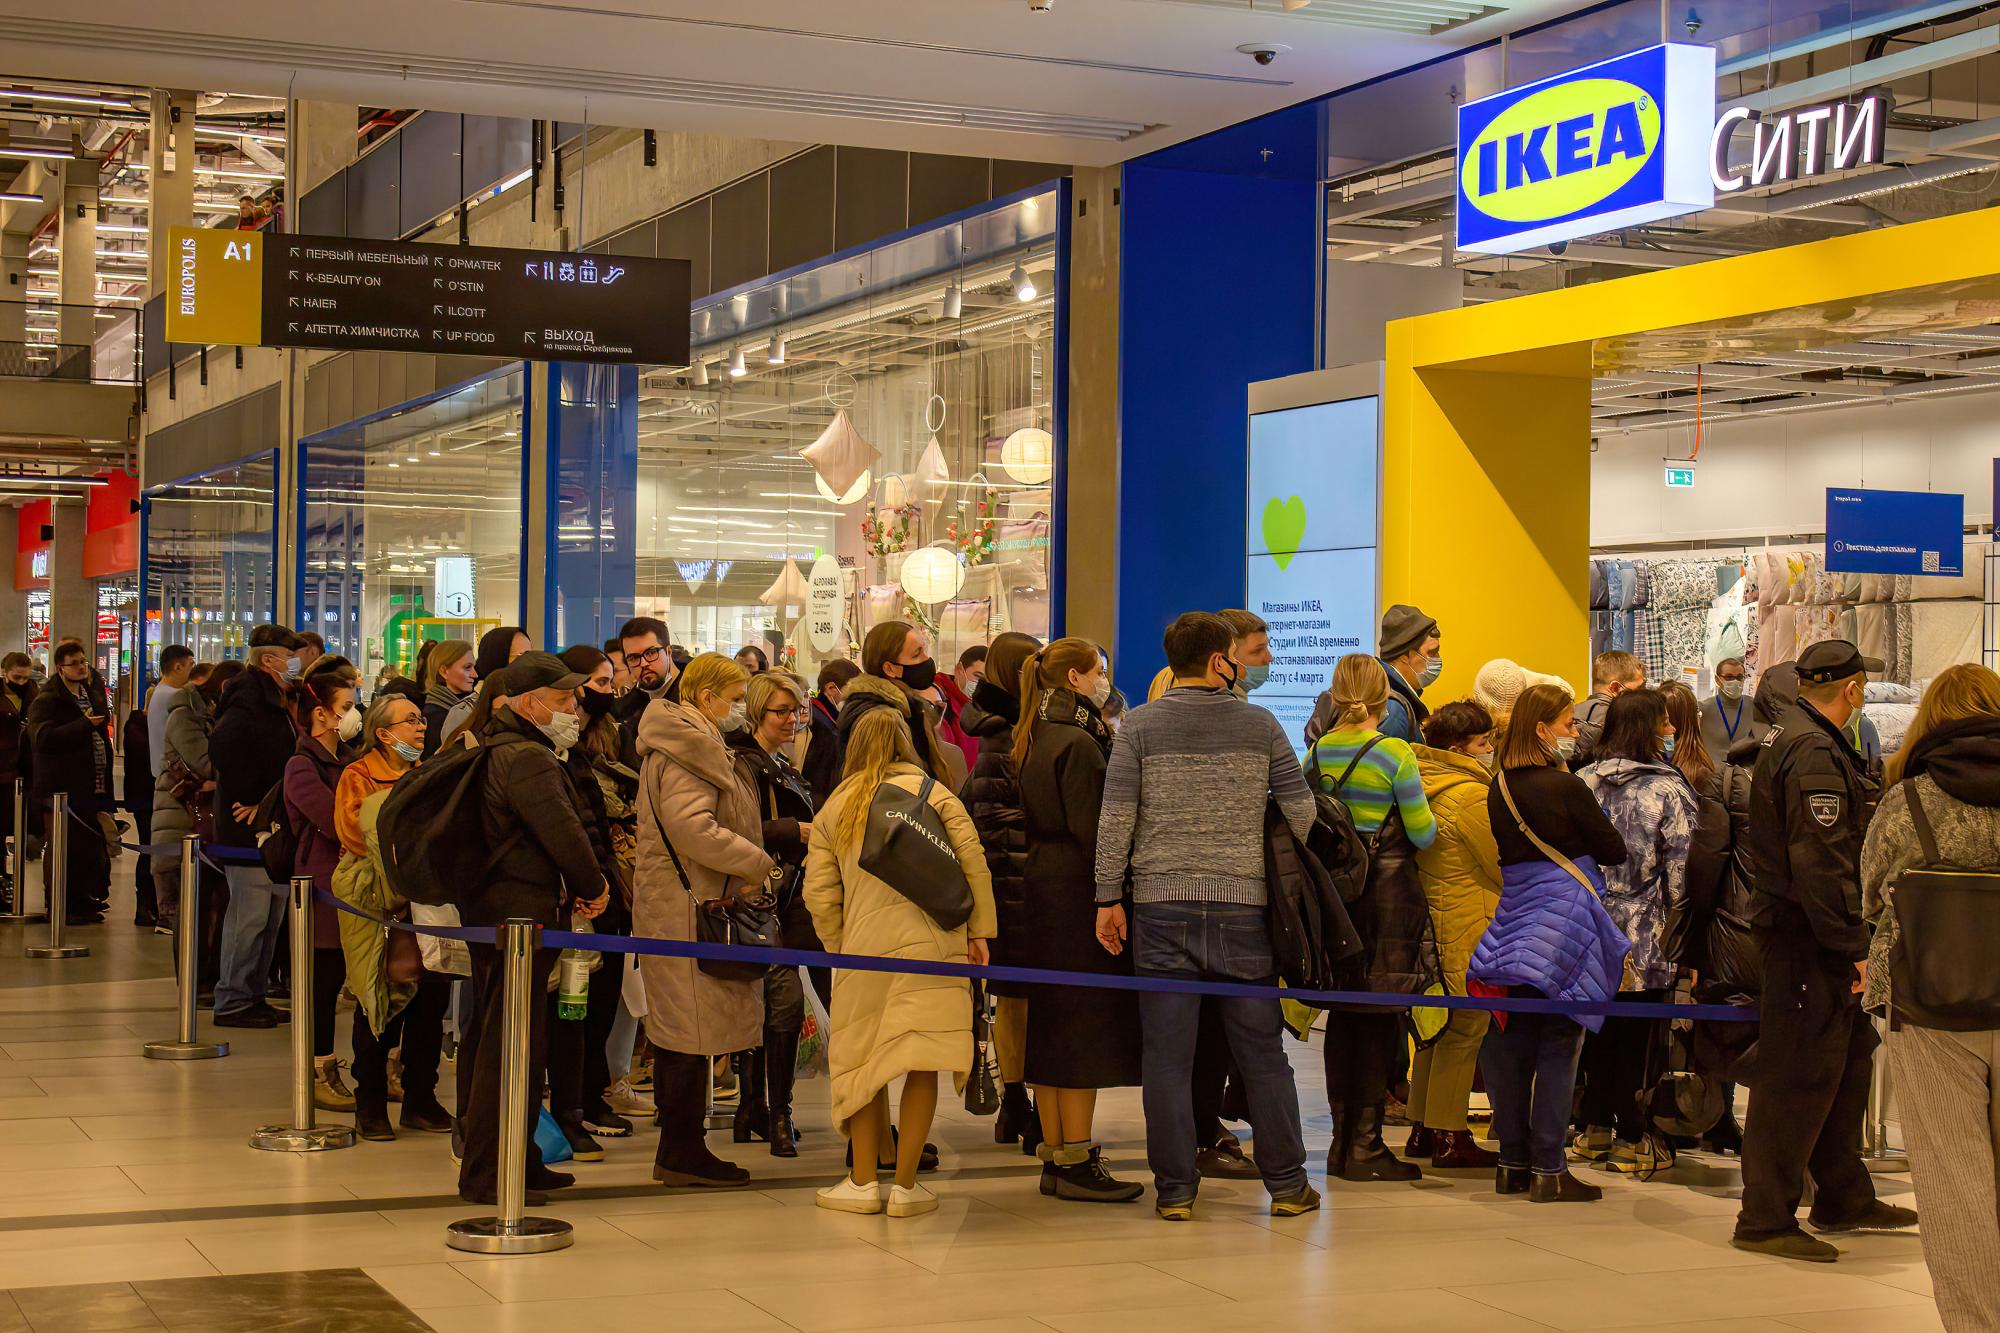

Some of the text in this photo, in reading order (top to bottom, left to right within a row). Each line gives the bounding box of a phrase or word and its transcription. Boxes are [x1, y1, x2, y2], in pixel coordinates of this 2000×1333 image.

[1478, 101, 1647, 197] IKEA
[223, 241, 251, 261] A1
[306, 248, 429, 266] ПЕРВЫЙ МЕБЕЛЬНЫЙ
[448, 258, 501, 271] ОРМАТЕК
[182, 238, 196, 315] EUROPOLIS
[306, 272, 381, 286] K-BEAUTY ON
[448, 280, 484, 292] O'STIN
[303, 298, 337, 309] HAIER
[448, 306, 487, 318] ILCOTT
[304, 323, 420, 339] АПЕТТА ХИМЧИСТКА
[446, 331, 495, 343] UP FOOD
[544, 329, 594, 344] ВЫХОД
[1262, 600, 1322, 613] Магазины ИКЕА,
[1267, 620, 1331, 633] нтернет-магазин
[1269, 635, 1360, 651] Студии ИКЕА временно
[1271, 656, 1335, 666] иостанавливают
[1266, 671, 1288, 686] аботу
[1293, 671, 1299, 683] 4
[1300, 673, 1323, 686] марта
[885, 810, 956, 860] CALVIN KLEIN
